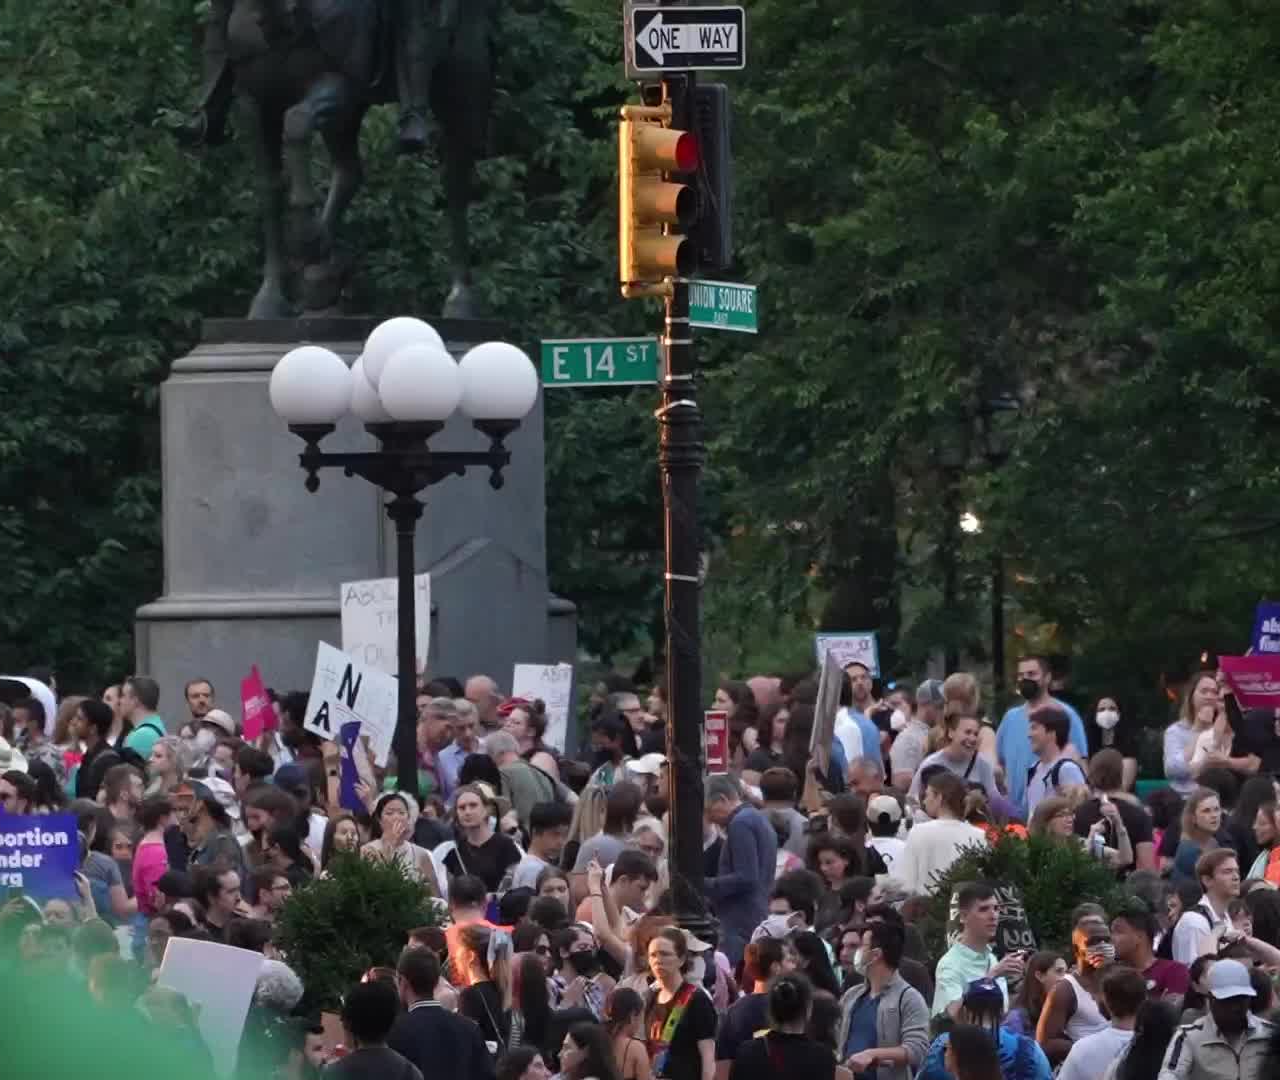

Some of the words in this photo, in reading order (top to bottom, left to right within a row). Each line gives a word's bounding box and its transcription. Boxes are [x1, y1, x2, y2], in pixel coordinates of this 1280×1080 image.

[648, 27, 681, 50] ONE
[699, 26, 734, 49] WAY
[718, 288, 753, 313] SQUARE
[552, 346, 571, 380] E
[583, 344, 616, 379] 14
[626, 344, 649, 362] ST
